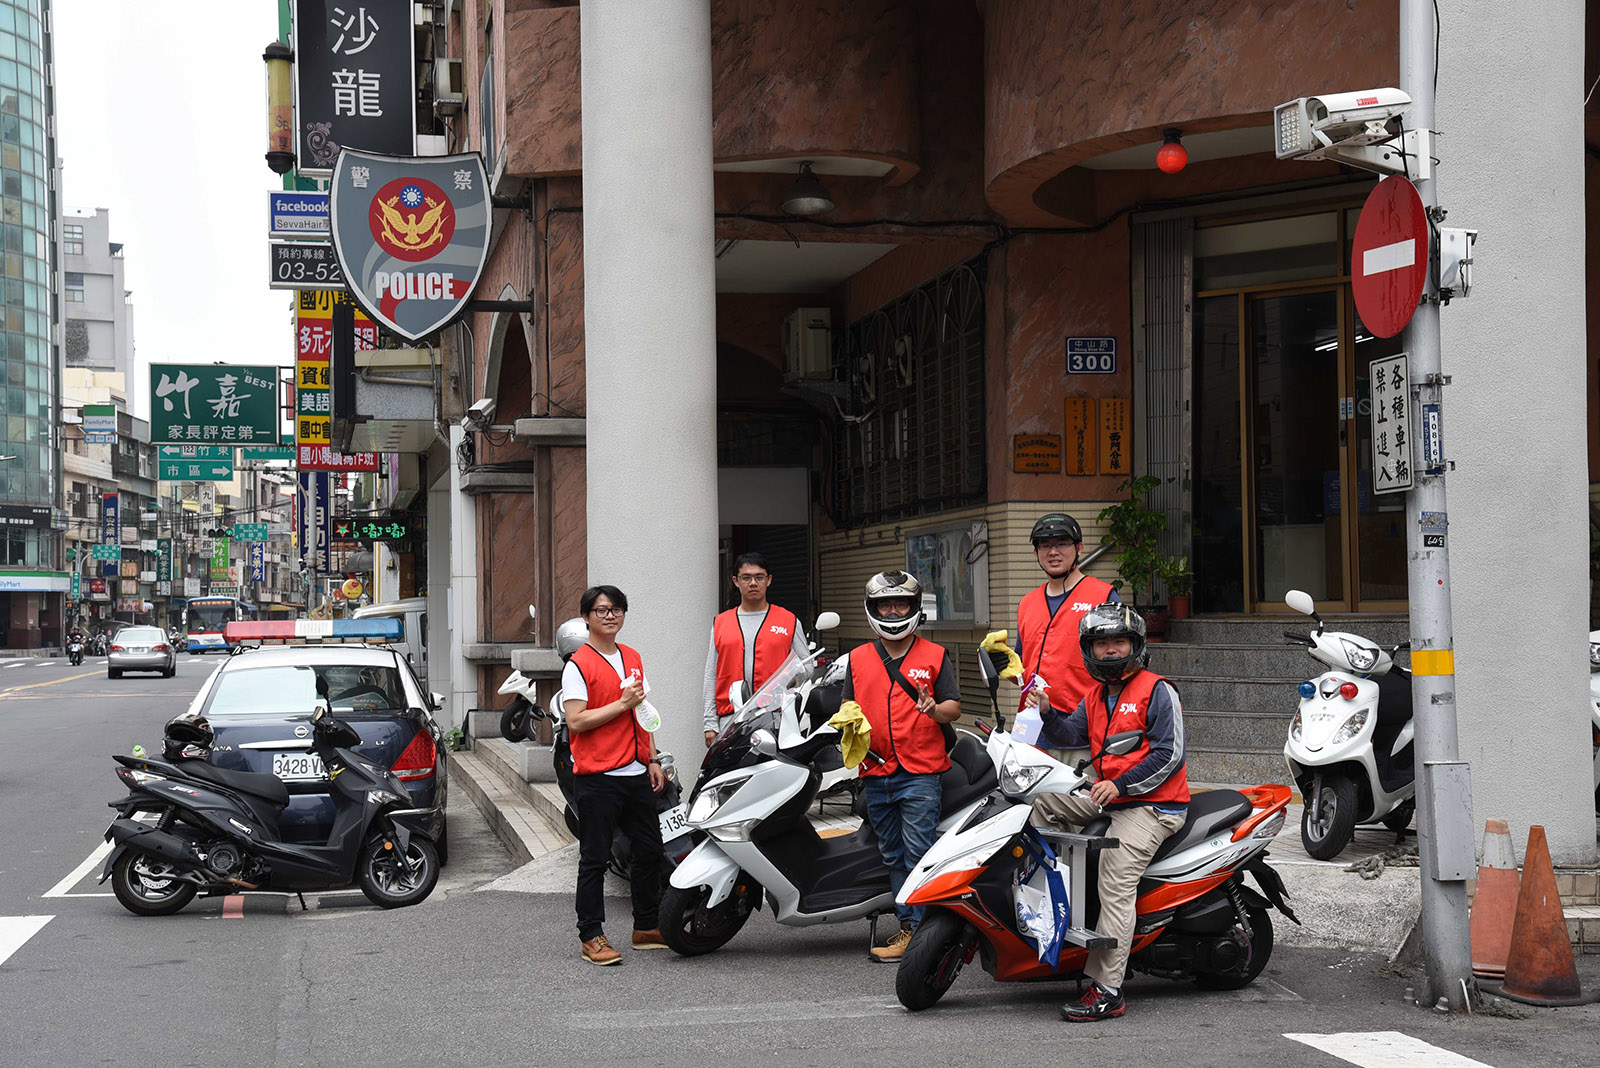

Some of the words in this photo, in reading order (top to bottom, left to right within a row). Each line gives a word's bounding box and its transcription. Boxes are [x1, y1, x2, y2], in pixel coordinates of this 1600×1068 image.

[330, 7, 383, 117] 沙龍
[351, 166, 370, 189] 警
[453, 169, 472, 190] 察
[276, 199, 329, 212] facebook
[375, 271, 455, 300] POLICE
[1072, 355, 1112, 370] 300
[244, 375, 276, 391] BEST
[301, 392, 330, 412] 美語
[1376, 366, 1393, 482] 禁止進入
[1391, 364, 1408, 484] 各種車輛
[168, 425, 271, 440] 家長評定第一
[167, 465, 201, 477] 市區
[303, 482, 326, 571] 自助餐
[1071, 602, 1092, 613] SYM
[770, 625, 788, 635] SYM
[908, 668, 930, 680] SYM
[1119, 702, 1137, 715] SYM
